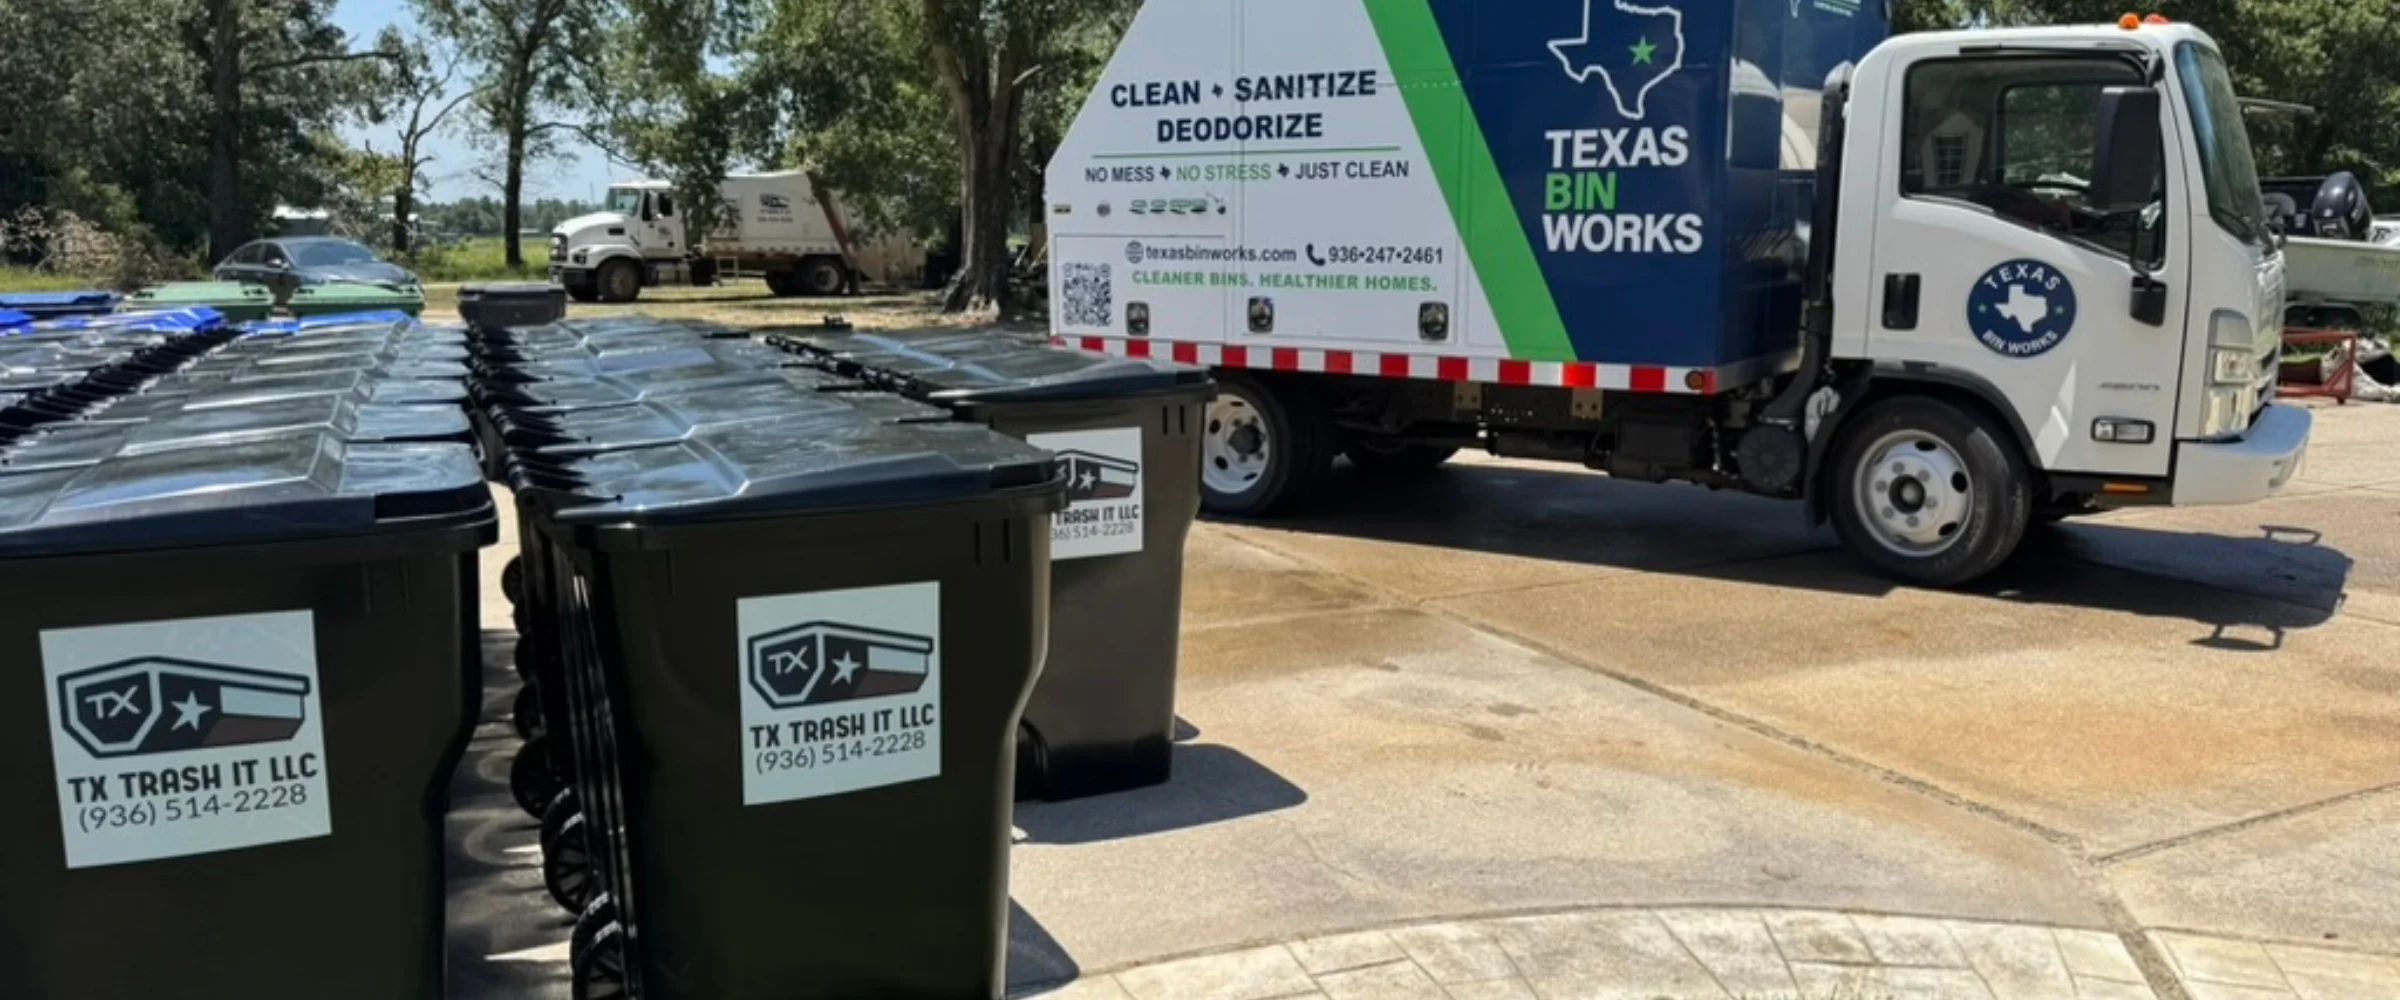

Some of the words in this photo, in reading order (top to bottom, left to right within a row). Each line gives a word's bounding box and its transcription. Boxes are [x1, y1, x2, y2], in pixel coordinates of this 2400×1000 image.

[1111, 80, 1201, 108] CLEAN
[1235, 70, 1377, 101] SANITIZE
[1157, 113, 1323, 142] DEODORIZE
[1545, 125, 1689, 168] TEXAS
[1085, 166, 1108, 182] NO
[1111, 166, 1155, 182] MESS
[1176, 165, 1200, 181] NO
[1204, 163, 1271, 181] STRESS
[1294, 162, 1340, 179] JUST
[1345, 160, 1409, 179] CLEAN
[1545, 171, 1616, 210] BIN
[1542, 213, 1703, 253] WORKS
[1146, 245, 1297, 262] texasbinworks.com
[1131, 270, 1205, 286] CLEANER
[1209, 272, 1254, 288] BINS.
[1260, 272, 1358, 290] HEALTHIER
[1365, 275, 1437, 292] HOMES.
[1983, 263, 2060, 290] TEXAS
[1982, 329, 2006, 350] BIN
[2008, 329, 2058, 353] WORKS
[1103, 506, 1115, 521] IT
[1118, 504, 1140, 519] LLC
[1073, 521, 1134, 539] 514-2228
[768, 645, 809, 675] TX
[84, 685, 141, 719] TX
[750, 724, 780, 749] TX
[789, 713, 865, 745] TRASH
[873, 708, 893, 733] IT
[901, 703, 935, 728] LLC
[755, 747, 816, 775] (936)
[822, 730, 926, 764] 514-2228
[67, 775, 108, 804] TX
[119, 764, 222, 799] TRASH
[232, 759, 258, 786] IT
[270, 753, 318, 781] LLC
[79, 803, 156, 833] (936)
[165, 784, 307, 822] 514-2228
